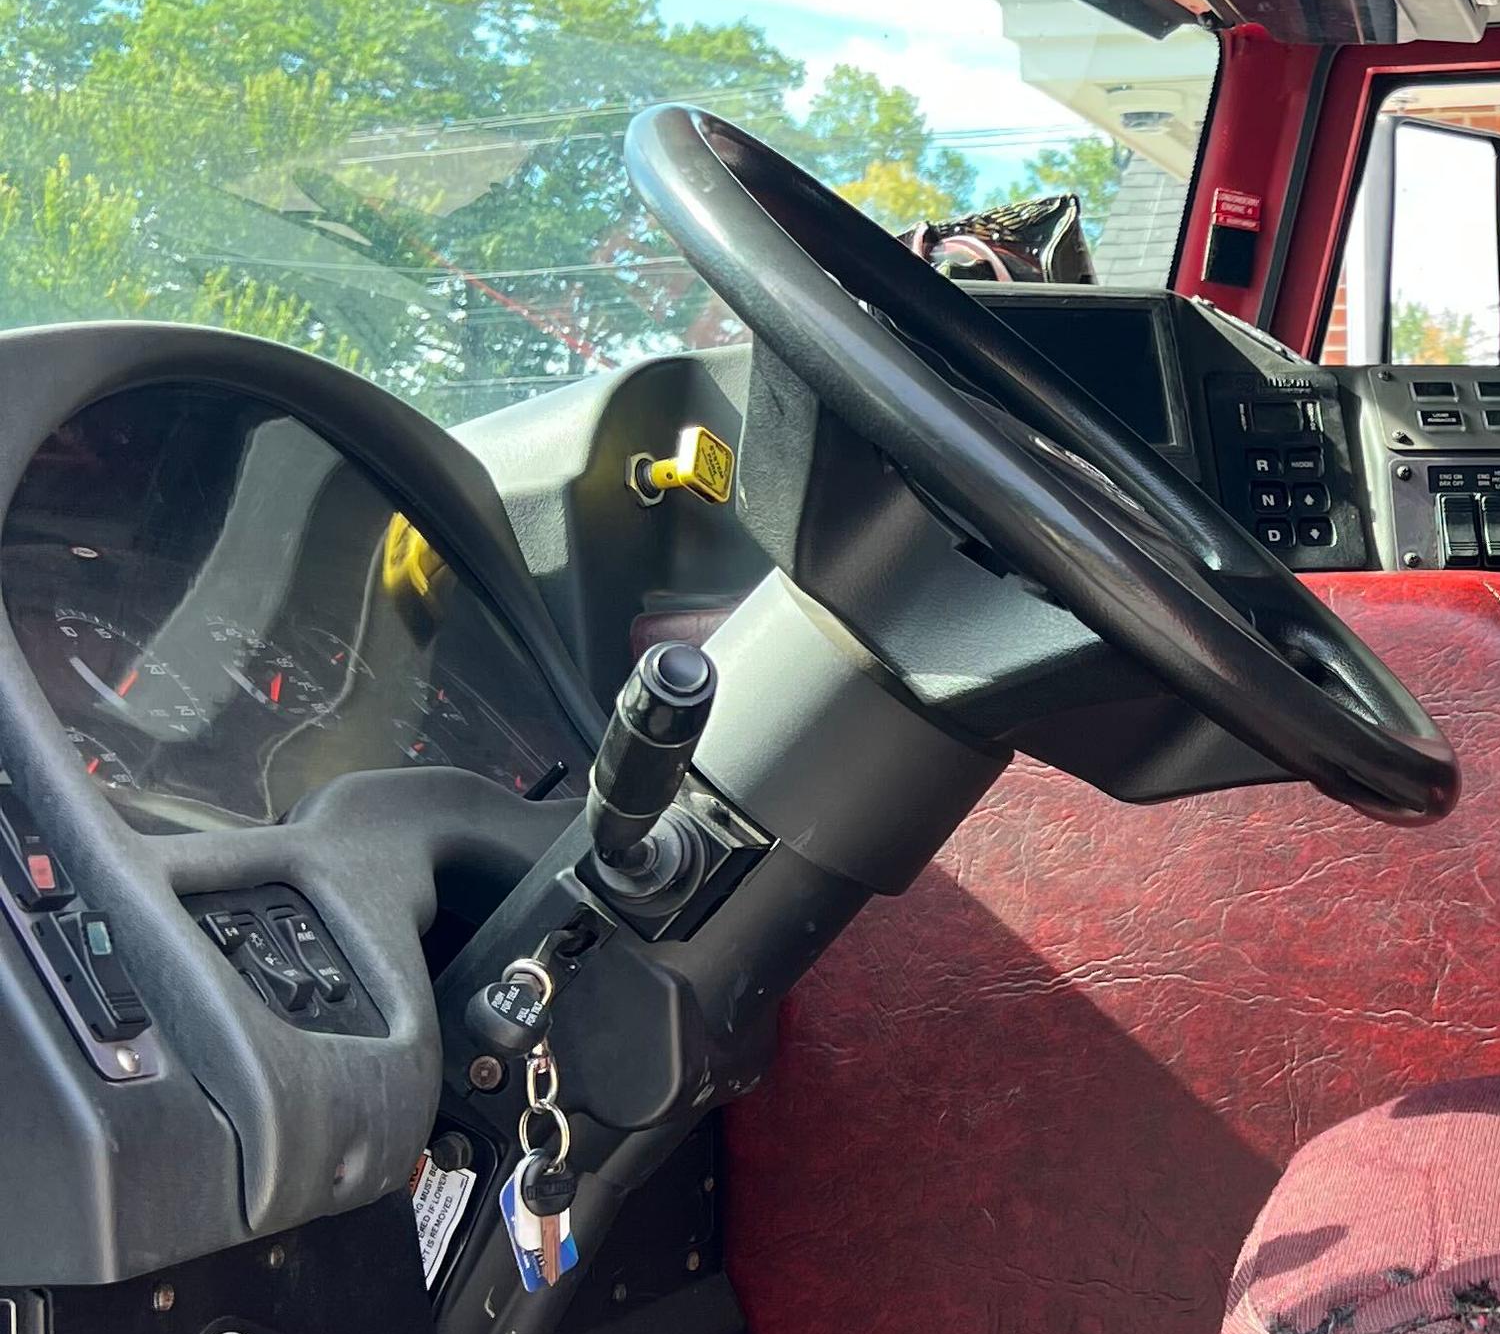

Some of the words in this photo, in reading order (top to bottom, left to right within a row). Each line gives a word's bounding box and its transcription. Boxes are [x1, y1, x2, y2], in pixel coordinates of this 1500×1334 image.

[1256, 459, 1269, 471] R
[1262, 494, 1275, 507] N
[1267, 529, 1281, 542] D
[420, 1178, 433, 1202] MUST
[433, 1173, 448, 1205] LOWER
[430, 1195, 453, 1240] REMOVED
